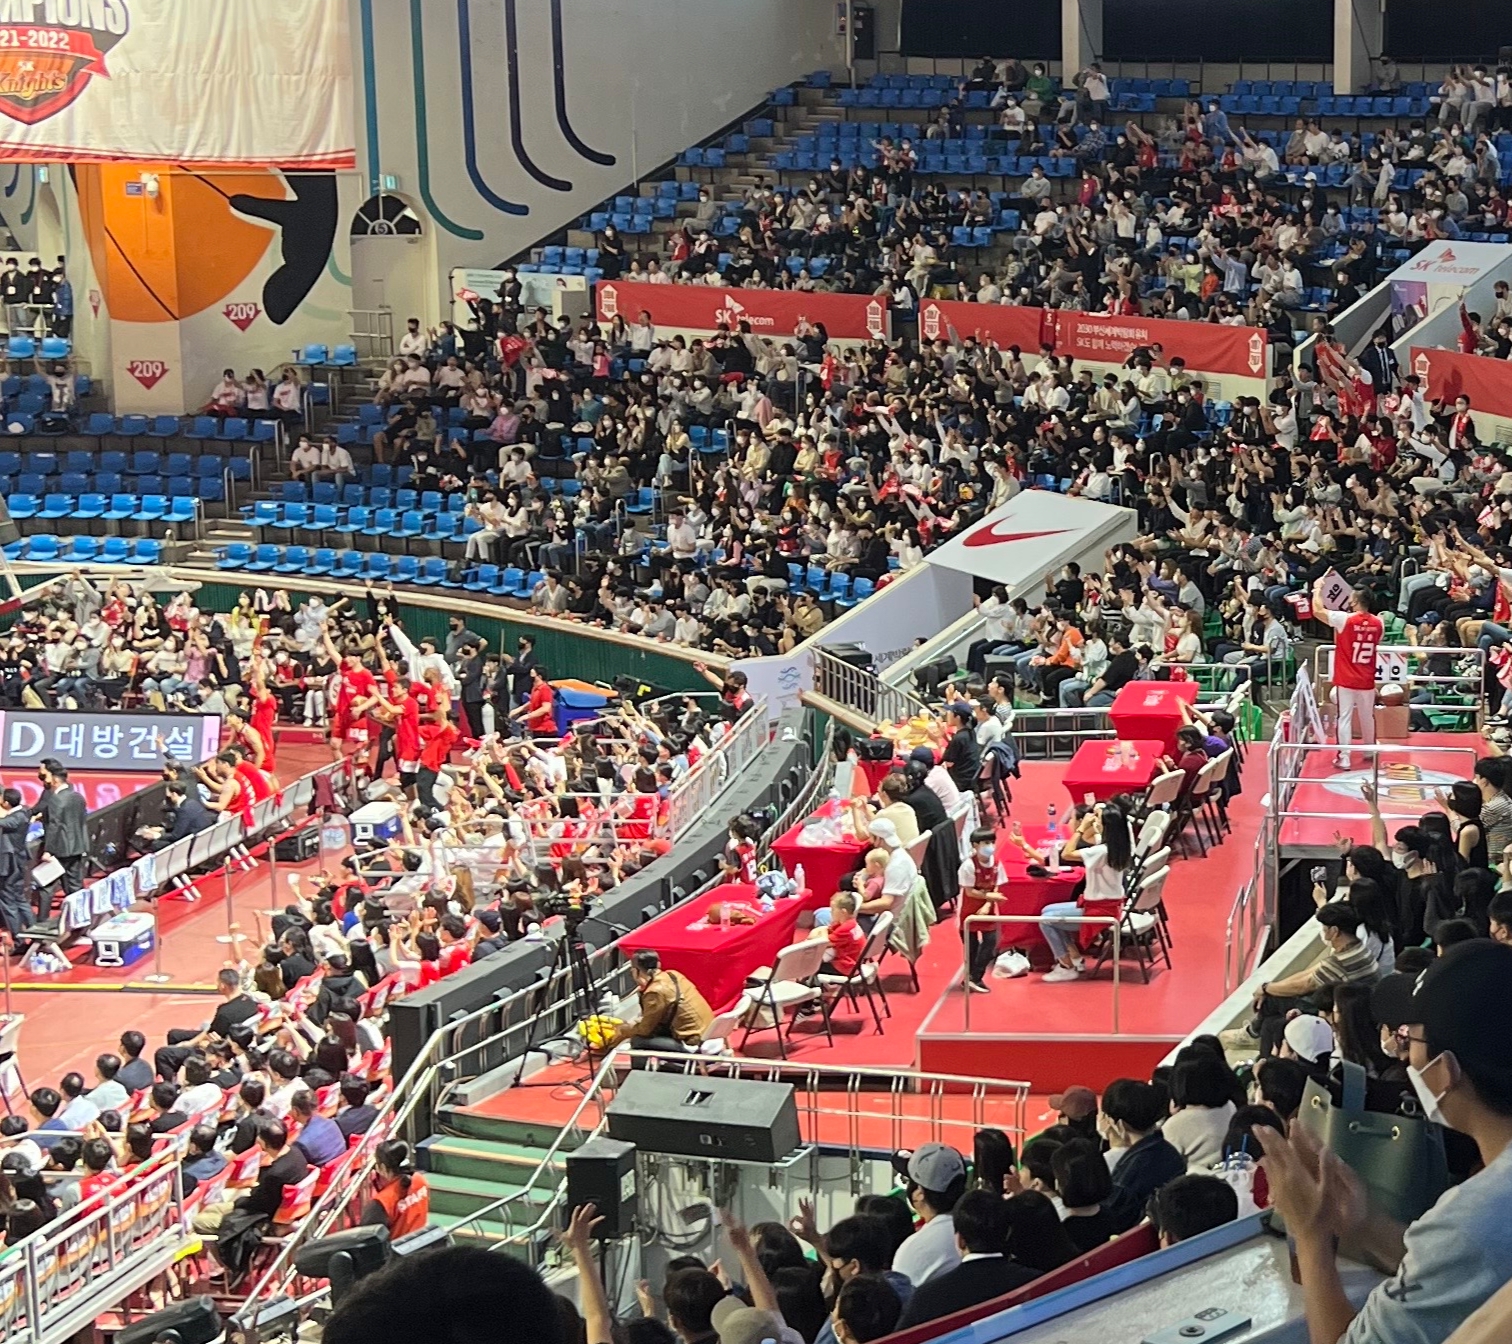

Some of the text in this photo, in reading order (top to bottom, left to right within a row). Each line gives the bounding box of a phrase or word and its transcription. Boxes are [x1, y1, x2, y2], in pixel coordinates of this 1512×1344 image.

[1409, 259, 1434, 272] SK
[227, 304, 256, 320] 209
[715, 308, 732, 324] SK
[133, 361, 163, 378] 209
[1352, 641, 1375, 664] 12
[54, 723, 194, 760] 대방건설
